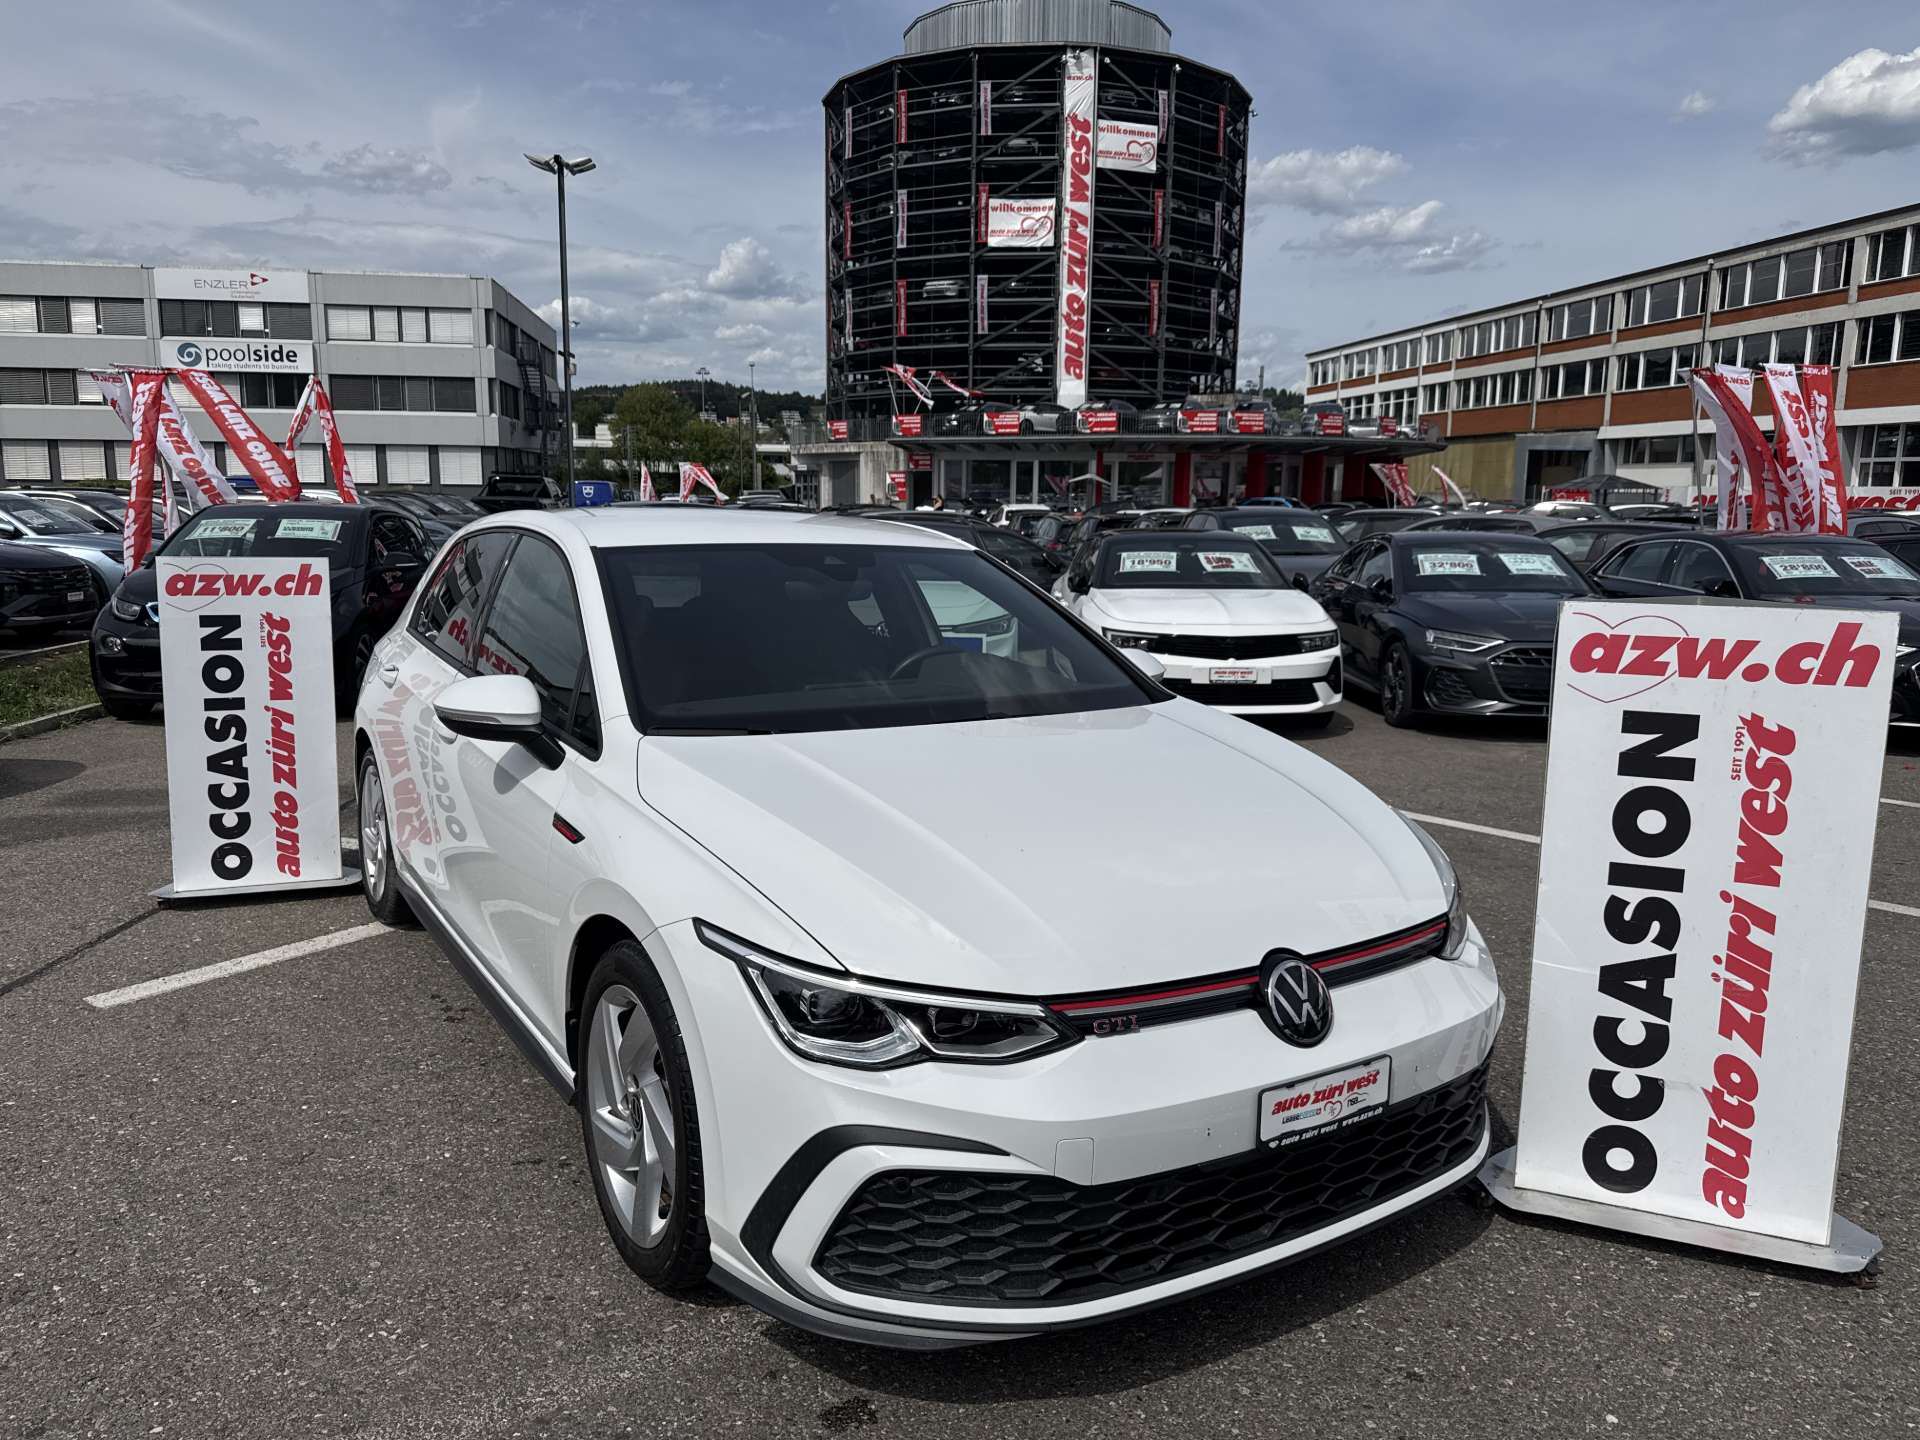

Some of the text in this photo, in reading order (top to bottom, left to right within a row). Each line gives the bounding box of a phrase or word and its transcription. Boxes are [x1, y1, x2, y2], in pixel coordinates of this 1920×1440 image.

[1097, 125, 1157, 138] willkommen
[990, 202, 1054, 213] willkommen
[1060, 112, 1092, 381] auto züri west
[194, 279, 249, 290] ENZLER
[206, 344, 298, 368] poolside
[214, 404, 258, 440] züri
[246, 440, 292, 488] auto
[165, 563, 323, 597] azw.ch
[1569, 622, 1882, 689] azw.ch
[199, 614, 254, 881] OCCASION
[260, 611, 302, 878] auto züri west
[1730, 726, 1745, 781] SEIT 1991
[1581, 710, 1701, 1195] OCCASION
[1701, 712, 1798, 1219] auto züri west
[1093, 1014, 1139, 1034] GTI
[1272, 1069, 1380, 1115] auto züri west
[1281, 1134, 1300, 1146] auto
[1301, 1126, 1319, 1139] züri
[1320, 1121, 1339, 1134] west
